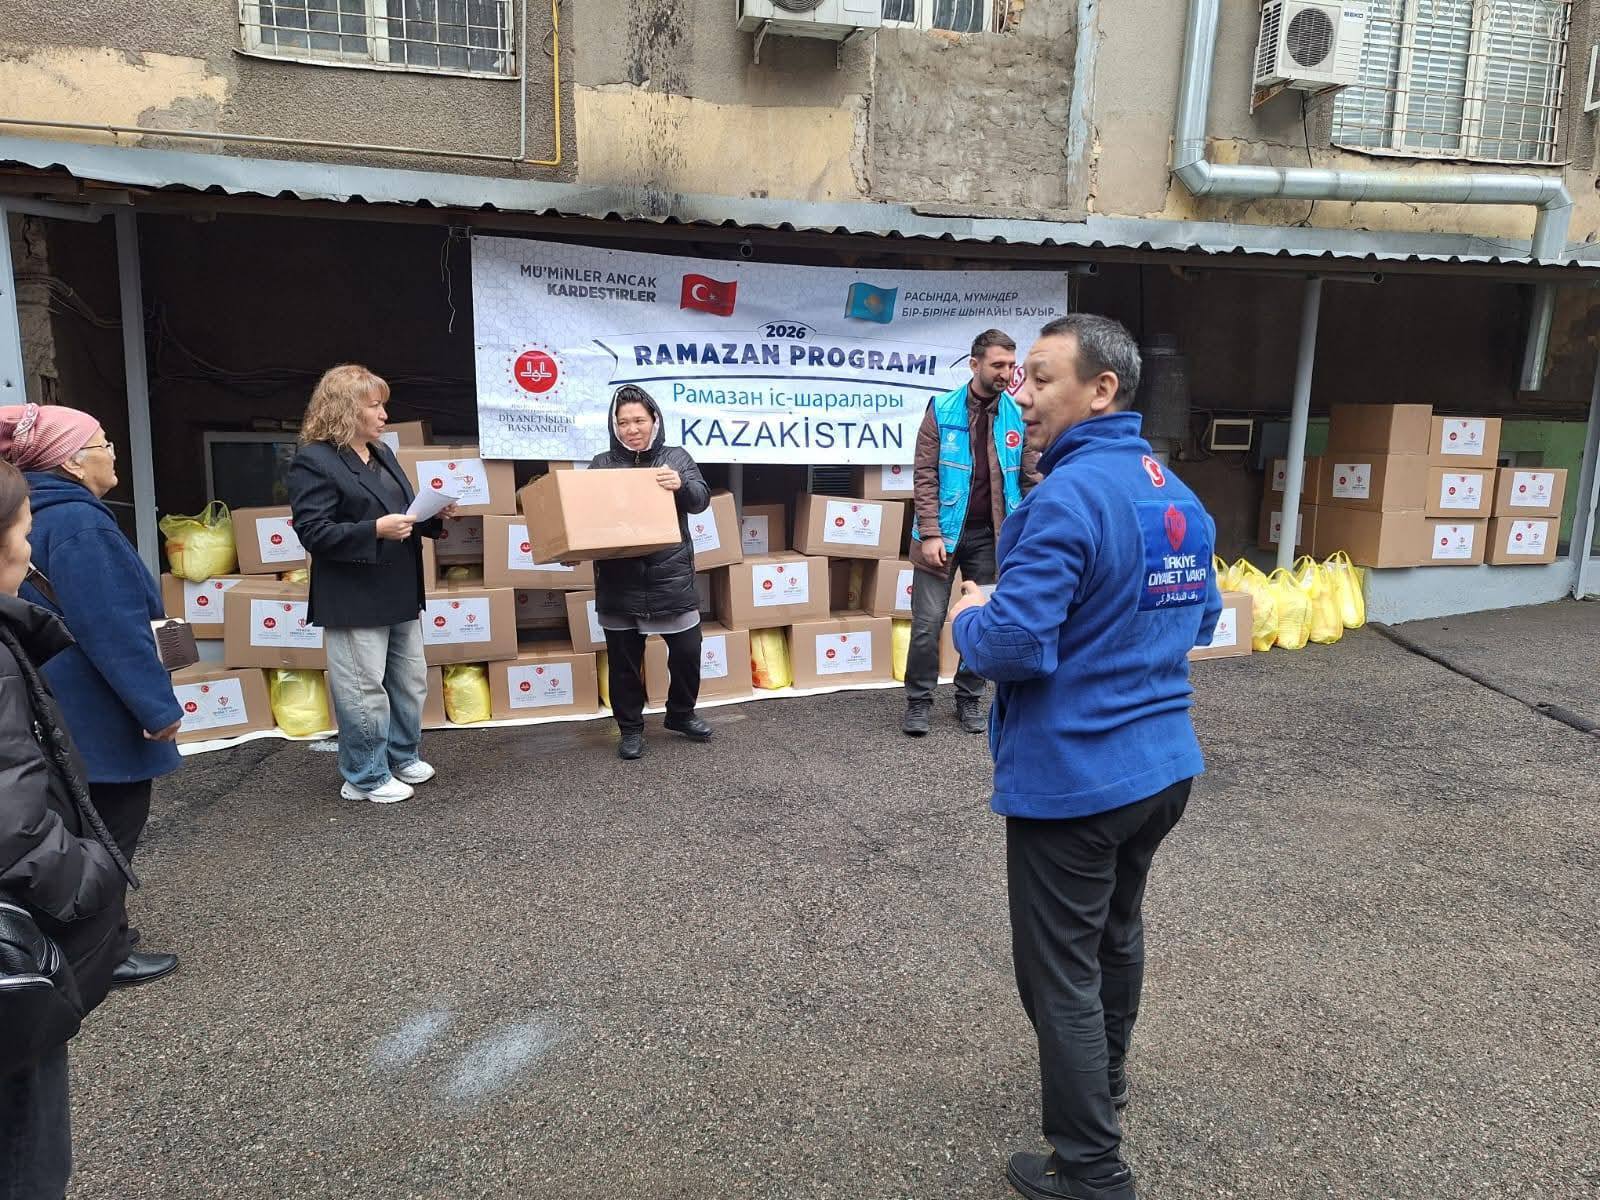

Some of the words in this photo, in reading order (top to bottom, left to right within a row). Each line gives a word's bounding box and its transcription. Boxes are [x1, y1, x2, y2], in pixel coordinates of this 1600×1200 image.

[606, 273, 657, 289] ANCAK
[547, 283, 656, 303] KARDEŞTİRLER
[904, 292, 960, 304] РАСЫНДА,
[902, 307, 956, 317] БІР-БІРІНЕ
[959, 305, 1012, 317] ШЫНАЙЫ
[766, 324, 806, 340] 2026
[634, 343, 780, 366] RAMAZAN
[790, 346, 937, 376] PROGRAMI
[673, 383, 763, 405] Рамазан
[770, 387, 903, 411] іс-шаралары
[499, 413, 543, 423] DİYANET
[681, 416, 902, 449] KAZAKİSTAN
